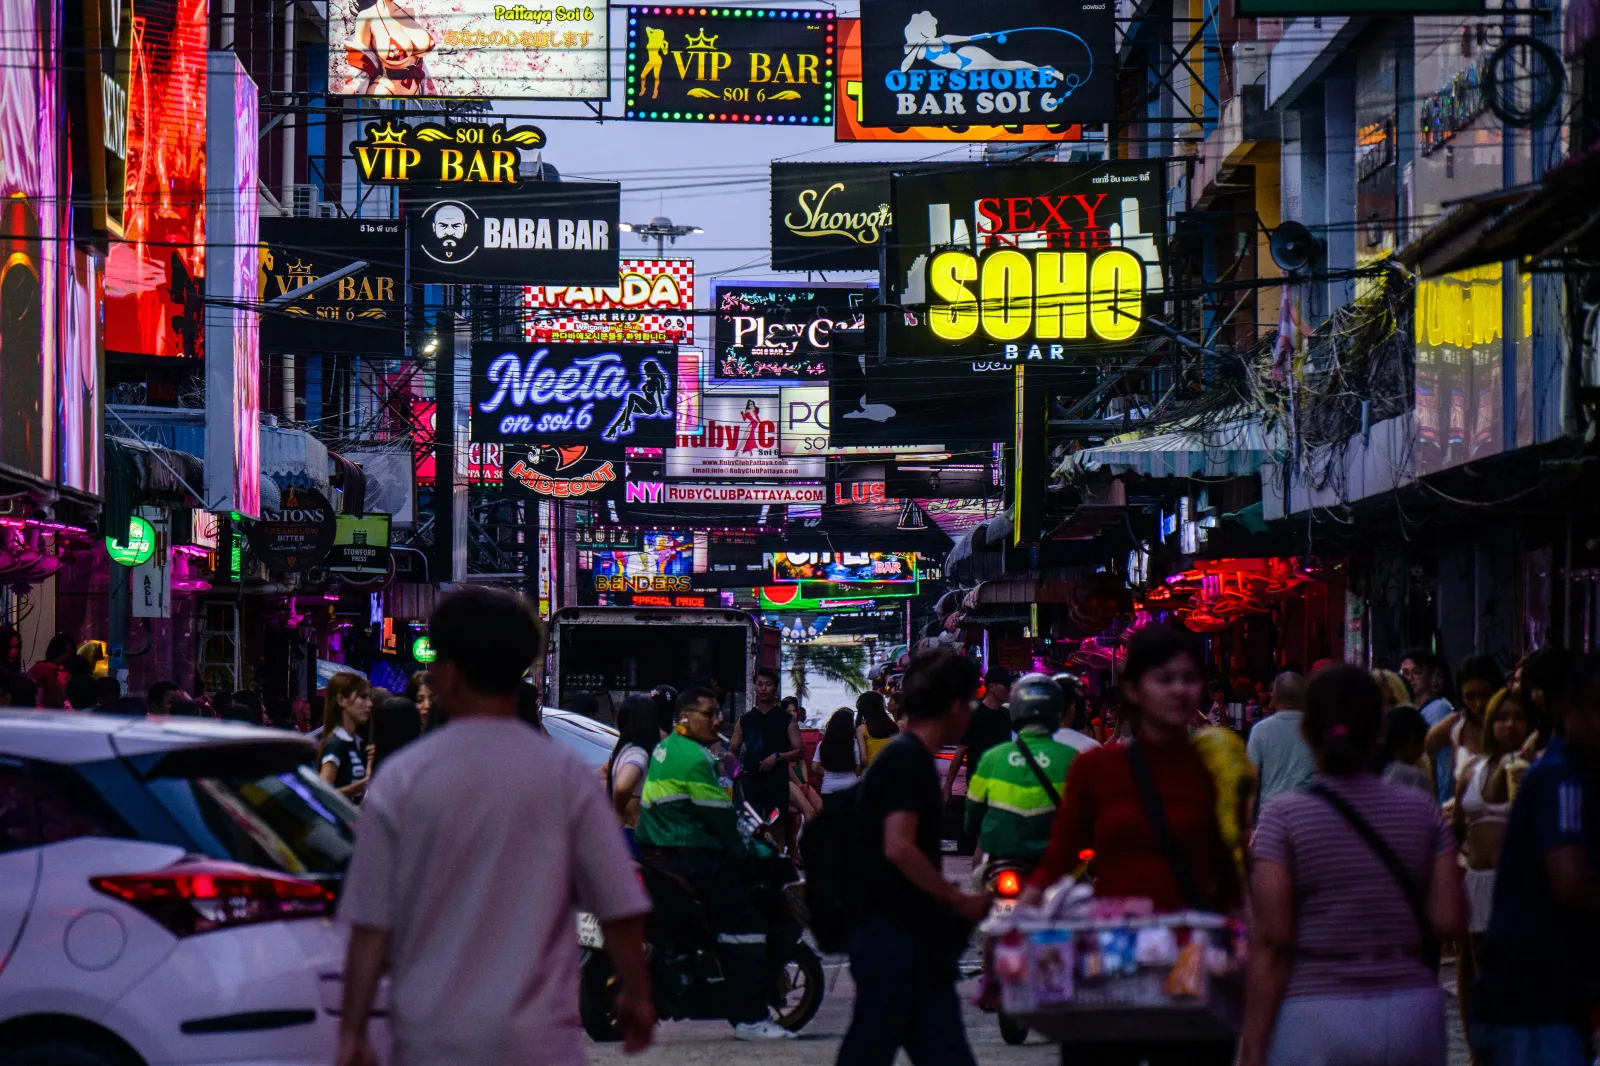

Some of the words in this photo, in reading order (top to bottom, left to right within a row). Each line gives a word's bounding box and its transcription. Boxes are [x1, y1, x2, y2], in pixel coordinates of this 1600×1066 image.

[494, 4, 552, 24] Pattaya
[555, 6, 580, 21] Soi
[583, 6, 594, 21] 6
[444, 29, 593, 48] あなたの心を癒します
[671, 50, 732, 82] VIP
[749, 52, 821, 84] BAR
[885, 68, 1057, 92] OFFSHORE
[723, 87, 749, 102] SOI
[757, 88, 765, 102] 6
[896, 93, 966, 115] BAR
[976, 91, 1030, 114] SOI
[1041, 91, 1058, 112] 6
[456, 128, 484, 144] SOI
[492, 128, 501, 144] 6
[356, 146, 421, 181] VIP
[440, 149, 517, 184] BAR
[977, 193, 1108, 235] SEXY
[484, 217, 552, 249] BABA
[558, 219, 609, 251] BAR
[338, 277, 395, 301] BAR
[542, 271, 682, 308] PANDA
[929, 249, 1144, 341] SOHO
[316, 306, 341, 320] SOI
[346, 307, 355, 321] 6
[1005, 344, 1065, 360] BAR
[499, 414, 534, 434] on
[536, 406, 573, 432] soi
[575, 402, 596, 430] 6
[509, 460, 617, 497] HIDEOUT
[835, 482, 900, 505] LUS
[343, 549, 376, 557] STOWFORD
[351, 555, 367, 563] PRESS
[876, 561, 901, 573] BAR
[595, 575, 691, 592] BENDERS
[632, 595, 672, 607] SPECIAL
[676, 597, 704, 607] PRICE
